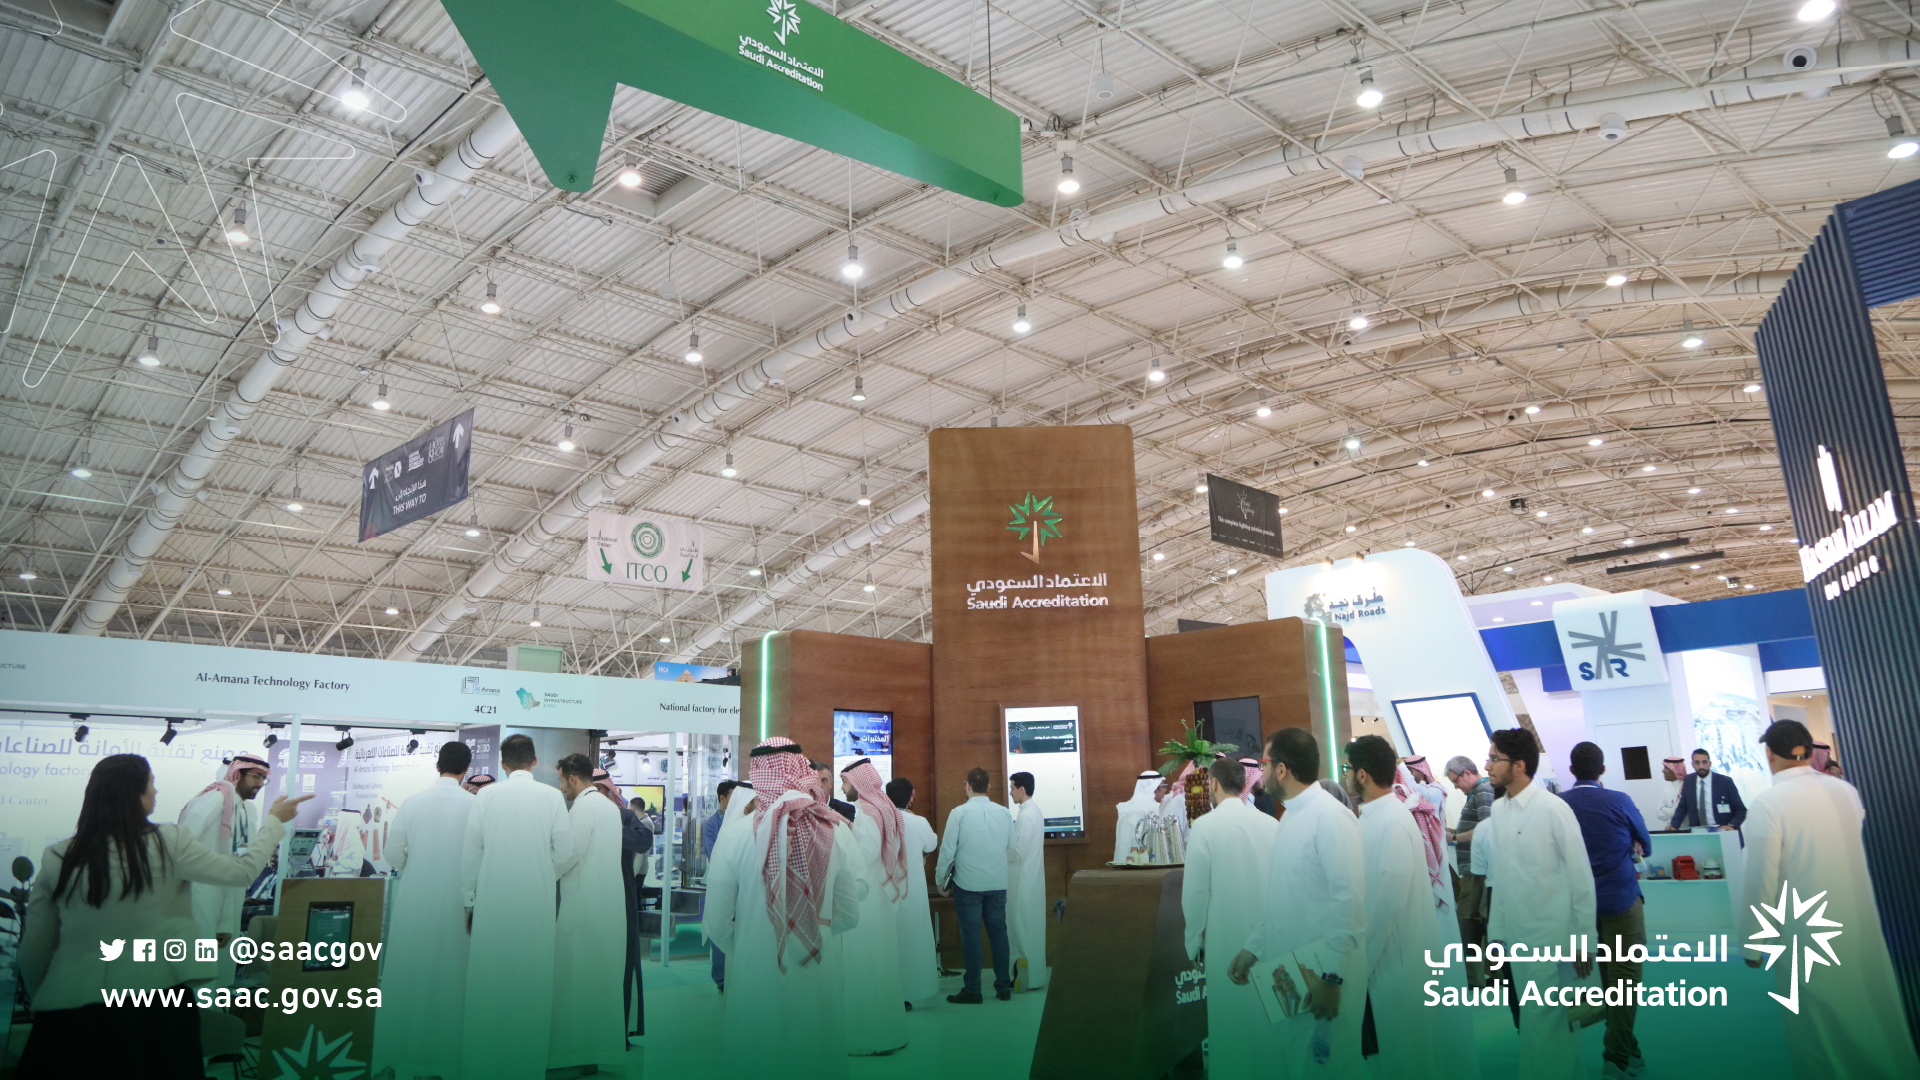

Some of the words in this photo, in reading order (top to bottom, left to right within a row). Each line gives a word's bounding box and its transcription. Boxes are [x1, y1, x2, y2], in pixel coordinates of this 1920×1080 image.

[738, 45, 765, 65] Saudi
[766, 58, 824, 92] Accreditation
[392, 502, 405, 515] THIS
[405, 496, 419, 510] WAY
[419, 493, 427, 505] TO
[626, 562, 668, 583] ITCO
[1046, 572, 1108, 588] الاعتماد
[966, 574, 1044, 596] السعودي
[966, 595, 1008, 610] Saudi
[1012, 594, 1109, 609] Accreditation
[1334, 610, 1355, 622] Najd
[1358, 606, 1386, 618] Roads
[195, 672, 250, 684] Al-Amana
[252, 675, 311, 691] Technology
[314, 679, 351, 693] Factory
[474, 705, 497, 715] 4C21
[660, 702, 690, 712] National
[692, 704, 716, 715] factory
[718, 705, 728, 713] for
[861, 734, 890, 744] المختبرات
[8, 795, 50, 806] Center
[1176, 985, 1201, 1004] Saudi
